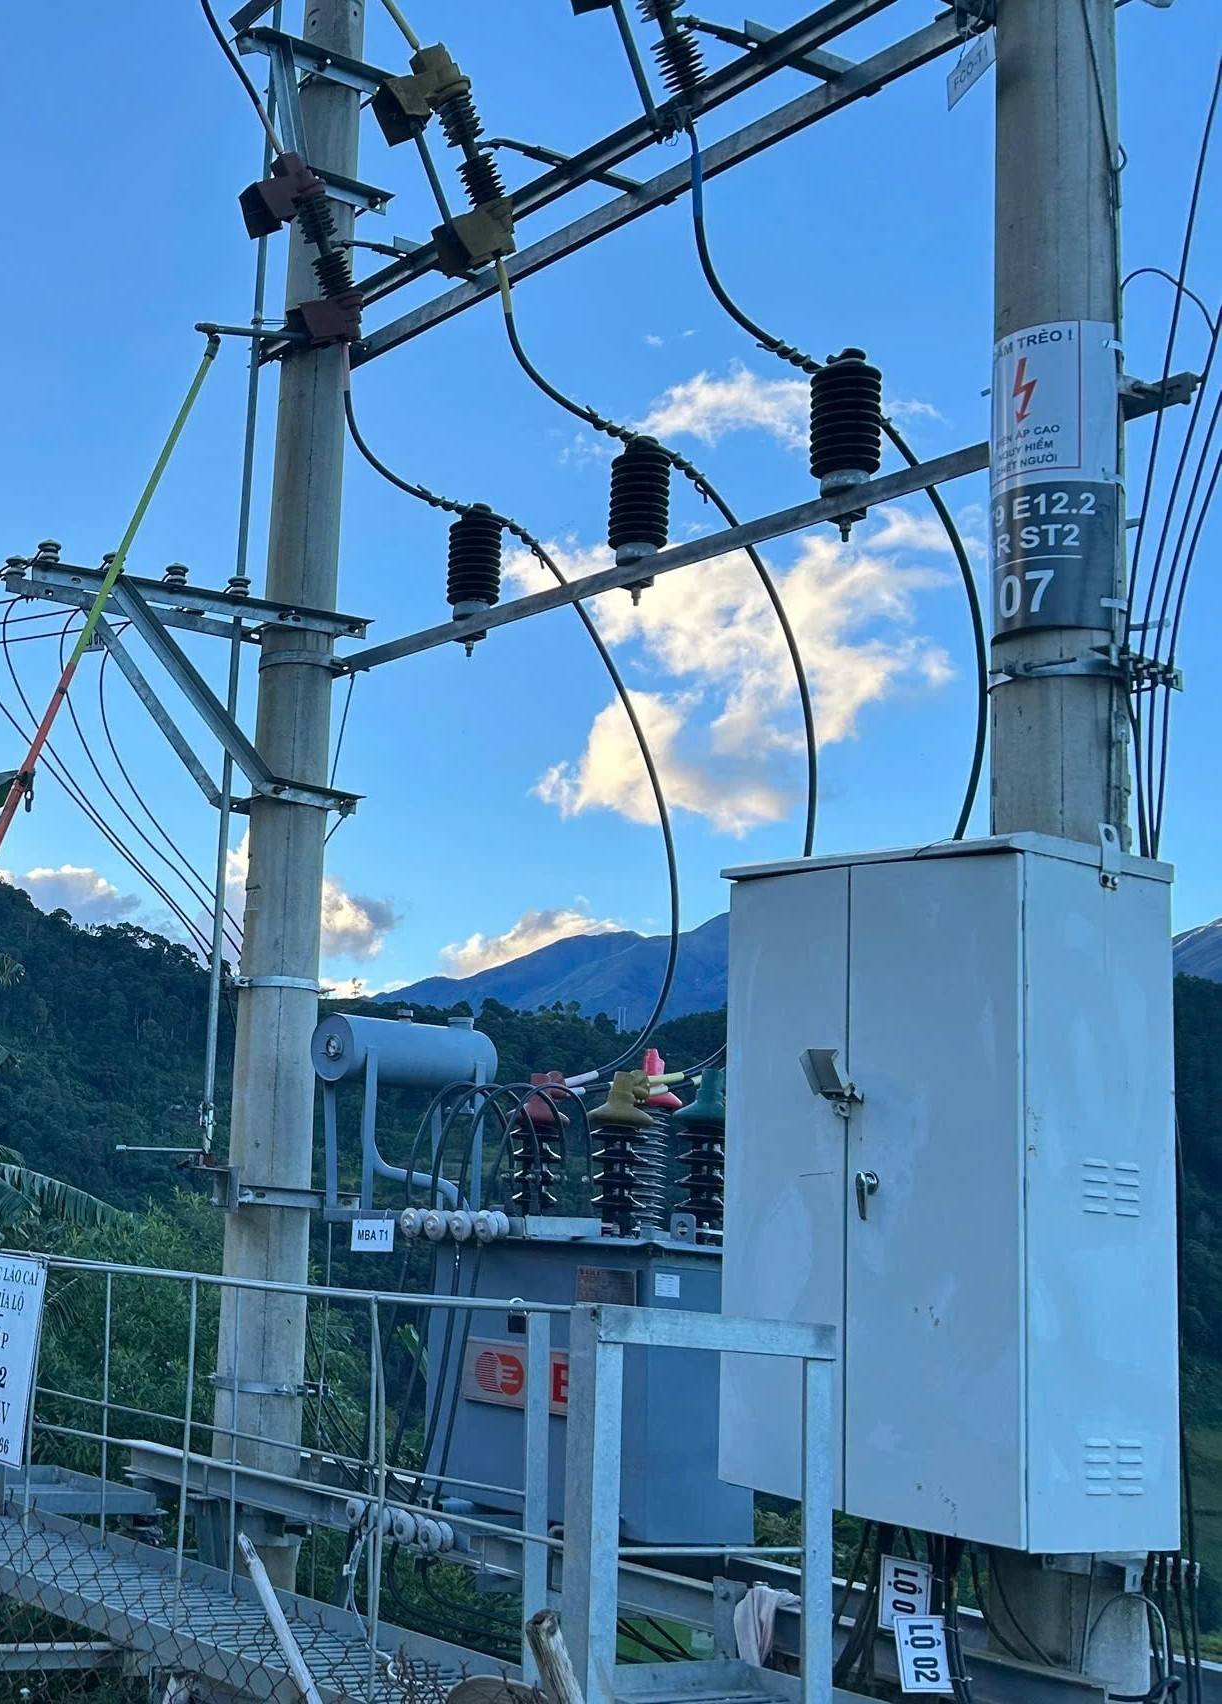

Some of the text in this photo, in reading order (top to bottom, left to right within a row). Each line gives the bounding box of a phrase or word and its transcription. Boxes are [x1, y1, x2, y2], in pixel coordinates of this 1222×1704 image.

[1033, 424, 1060, 435] CAO
[1025, 437, 1053, 453] HIỂM
[1019, 452, 1058, 467] NGƯỜI
[1012, 491, 1096, 520] E12.2
[1019, 523, 1081, 549] ST2
[999, 569, 1055, 619] 07
[358, 1229, 388, 1240] MBA T1
[3, 1264, 22, 1284] LÀO
[12, 1290, 25, 1316] LỘ
[888, 1567, 922, 1595] LỘ
[905, 1624, 941, 1682] LỘ 02
